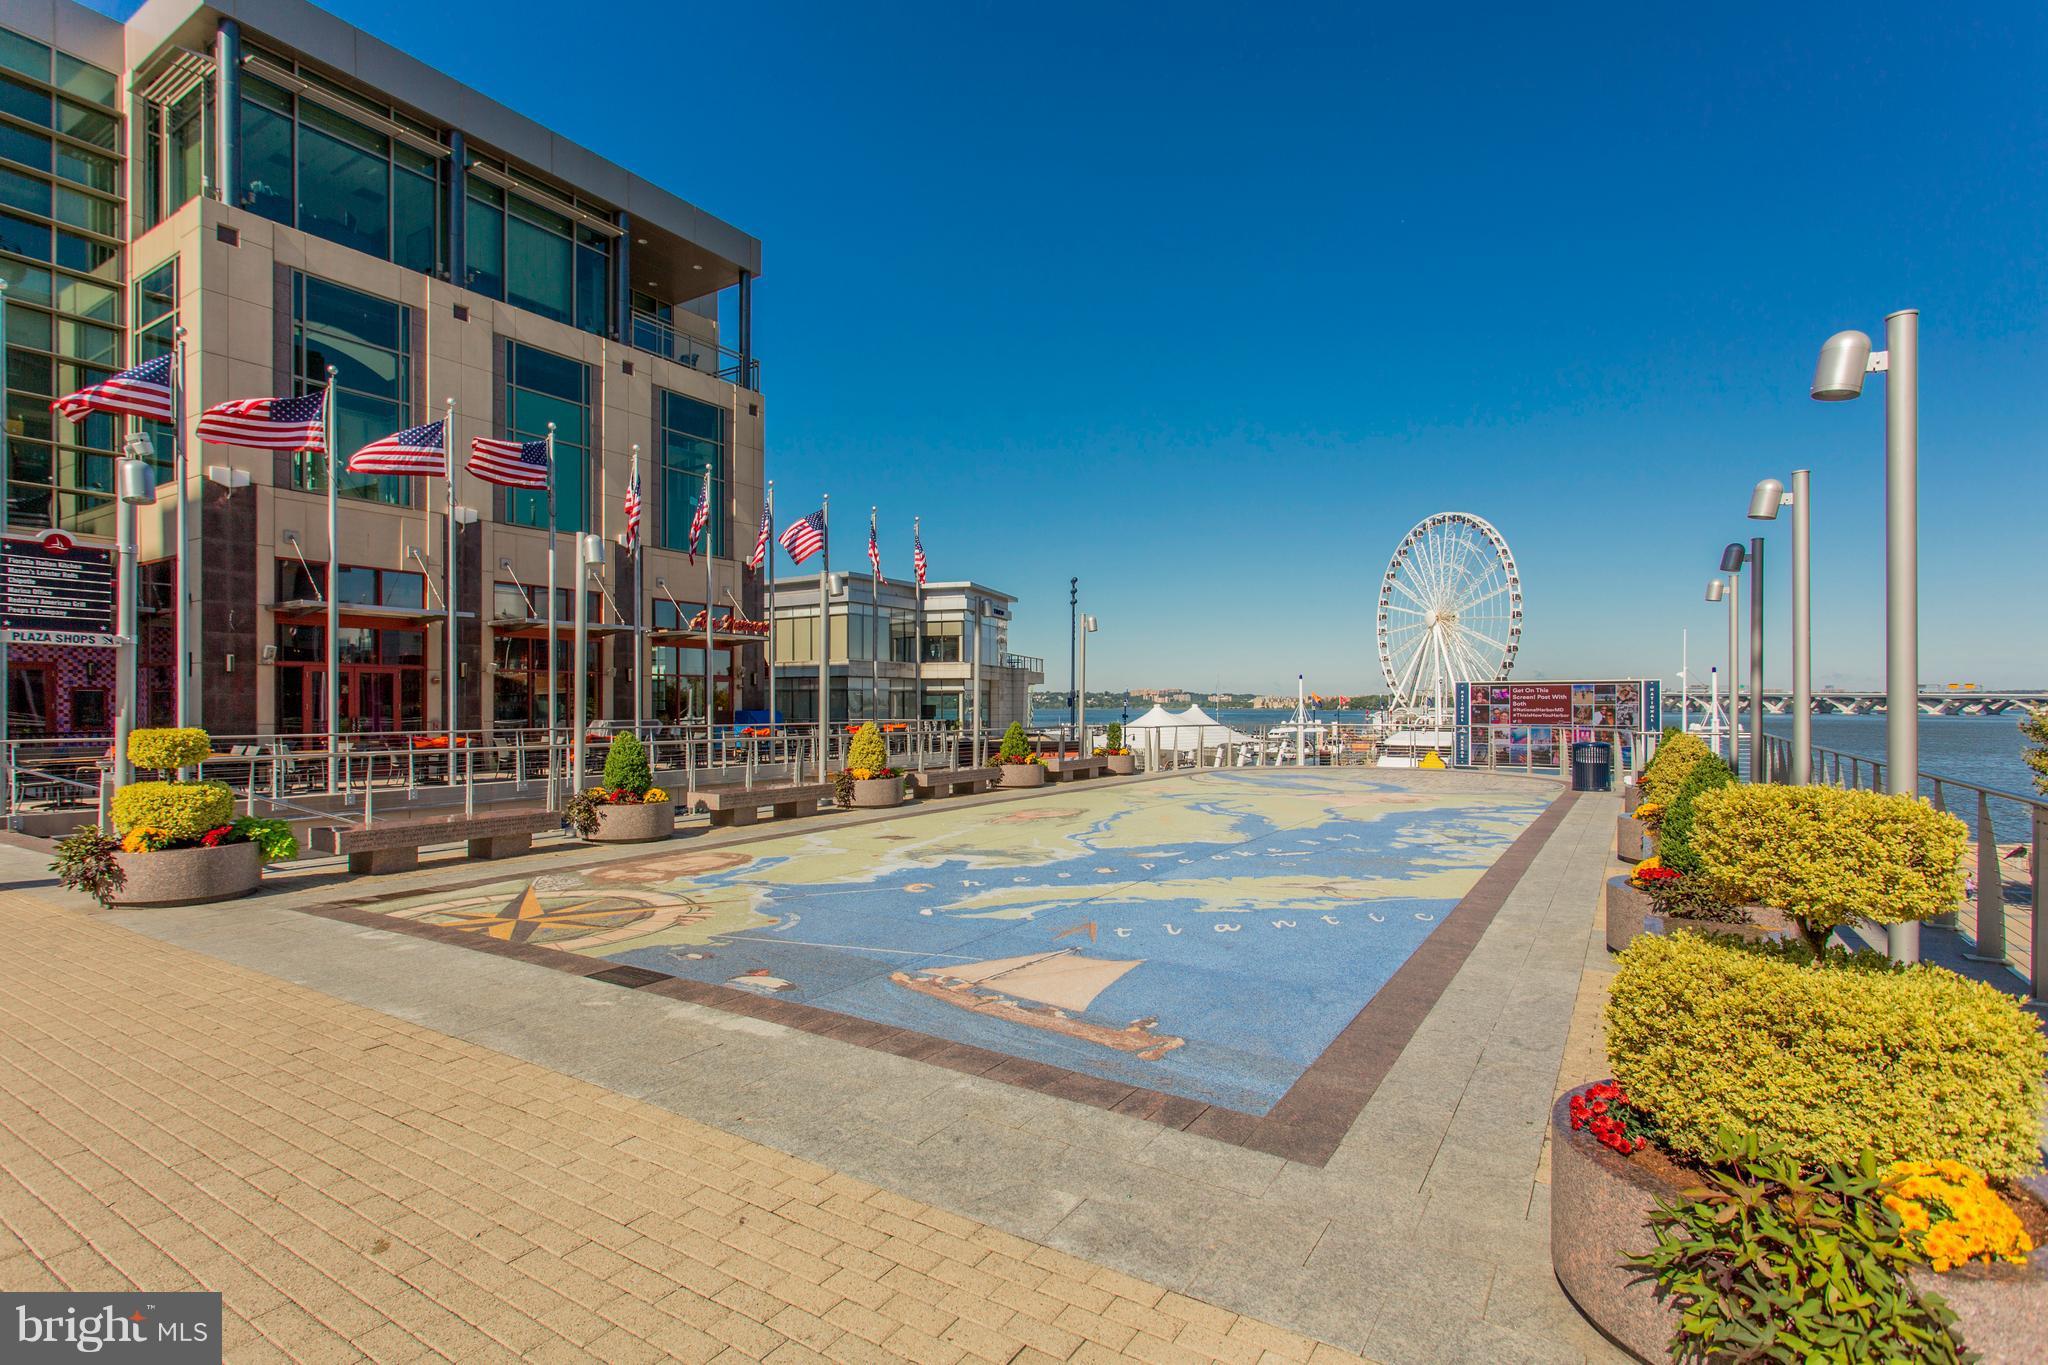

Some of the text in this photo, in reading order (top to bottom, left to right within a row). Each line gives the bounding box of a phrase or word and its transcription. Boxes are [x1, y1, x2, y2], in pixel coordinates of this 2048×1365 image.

[35, 560, 57, 568] Italian
[58, 562, 82, 570] Kitchen
[36, 569, 61, 577] Lobster
[62, 571, 79, 579] Rolls
[8, 576, 36, 585] Chipotle
[8, 586, 52, 596] Marina Office
[40, 598, 71, 606] American
[8, 606, 29, 614] Peeps
[37, 608, 67, 617] Company
[12, 631, 96, 644] PLAZA SHOPS
